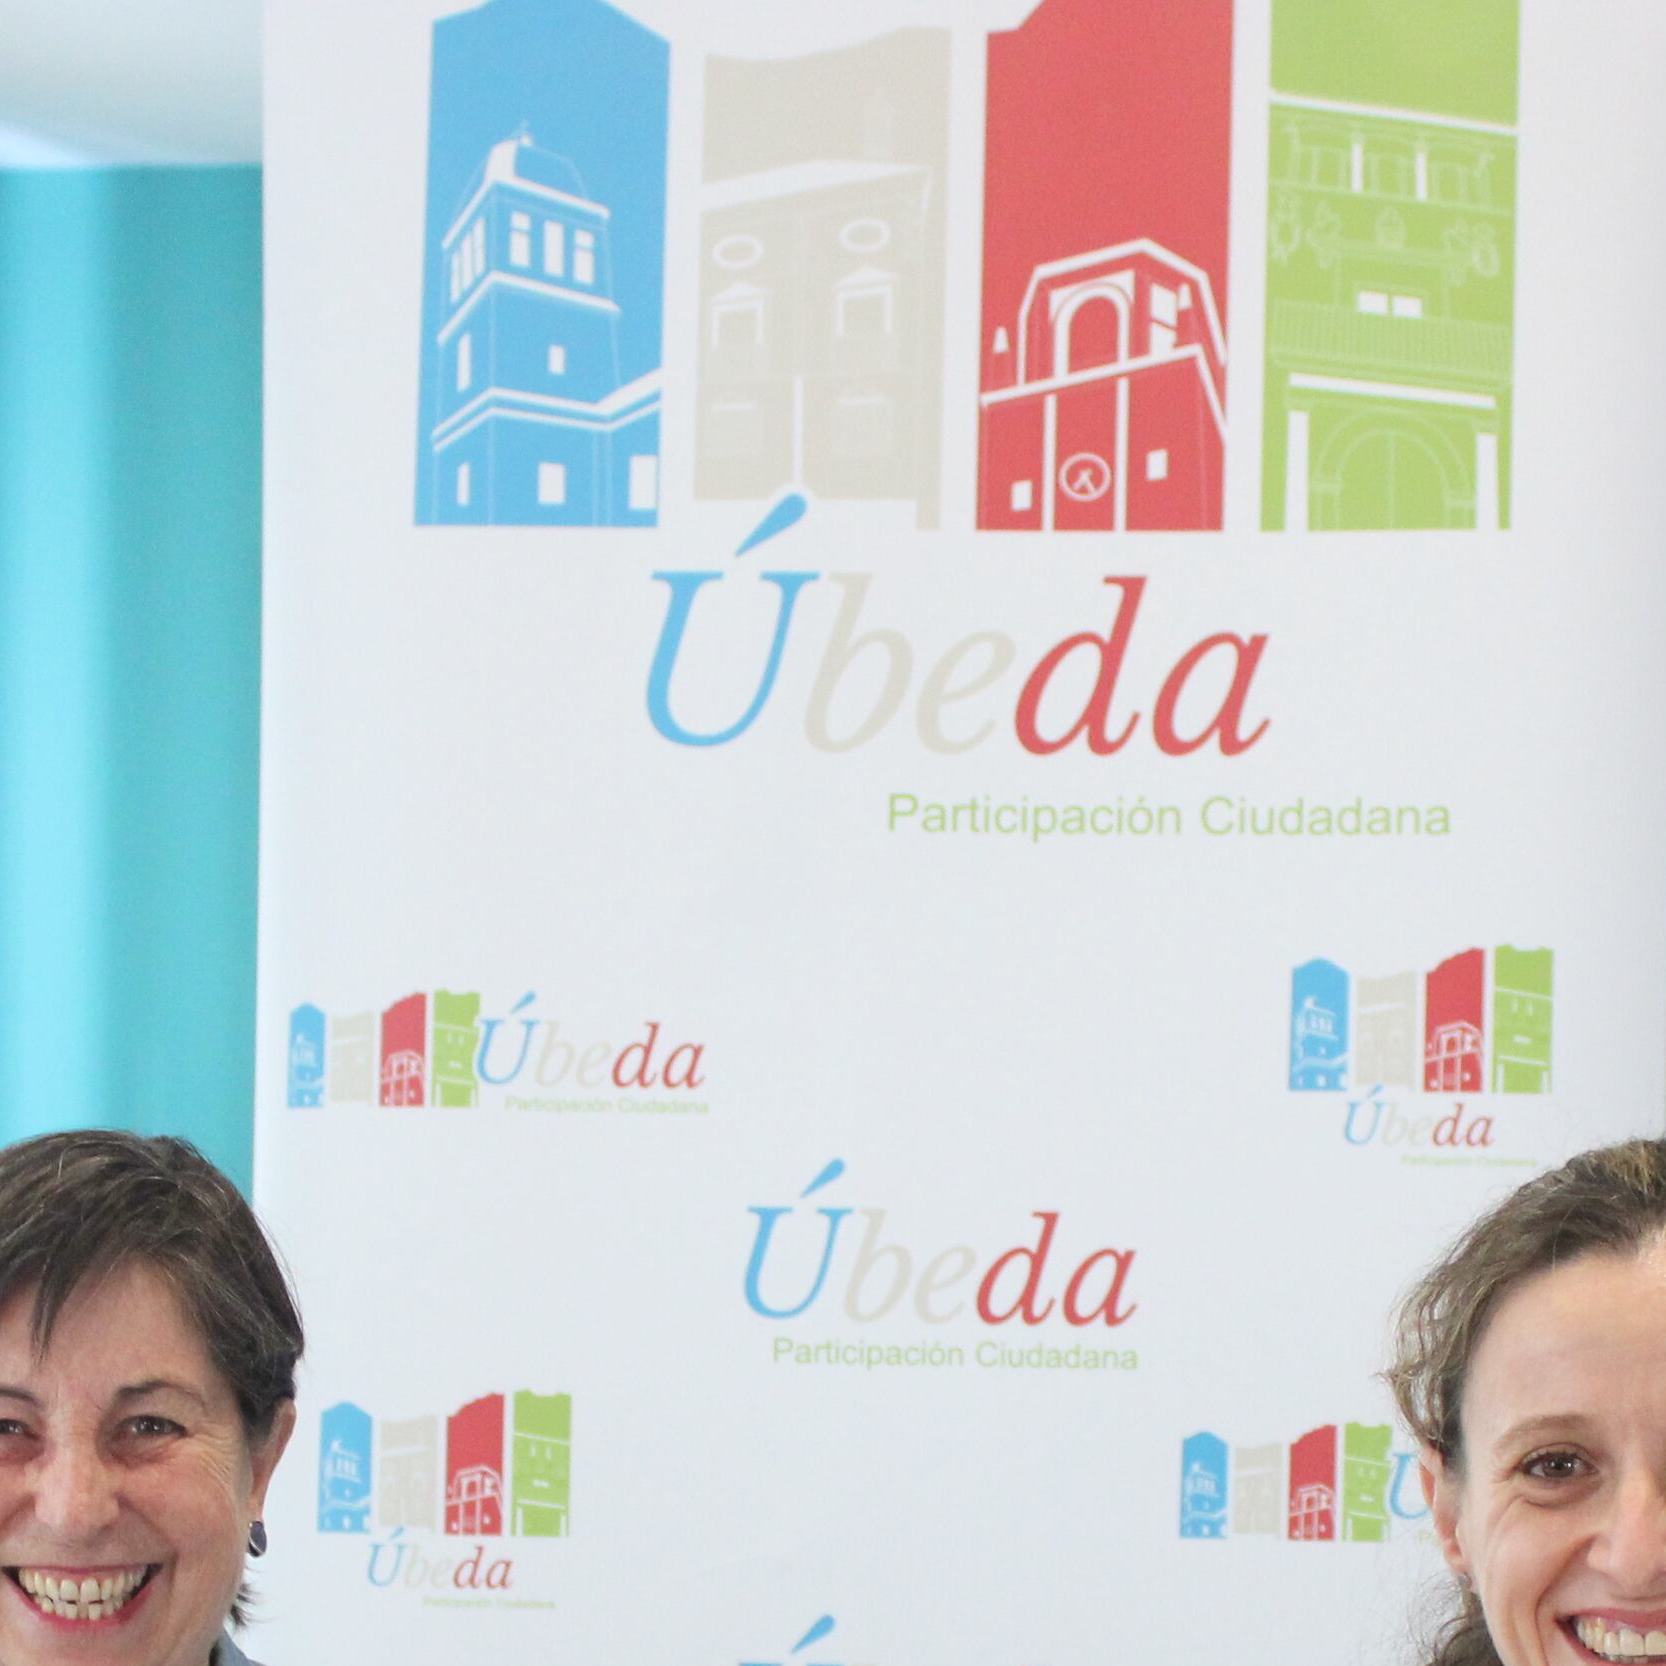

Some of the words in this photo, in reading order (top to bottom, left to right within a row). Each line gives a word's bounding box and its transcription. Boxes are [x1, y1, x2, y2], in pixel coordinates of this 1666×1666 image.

[643, 490, 1270, 756] Úbeda
[885, 793, 1185, 839] Participación
[1197, 797, 1452, 834] Ciudadana
[477, 990, 705, 1089] Úbeda
[1343, 1084, 1495, 1147] Úbeda
[740, 1158, 1138, 1327] Úbeda
[771, 1337, 965, 1371] Participación
[976, 1338, 1138, 1371] Ciudadana
[367, 1526, 512, 1590] Úbeda
